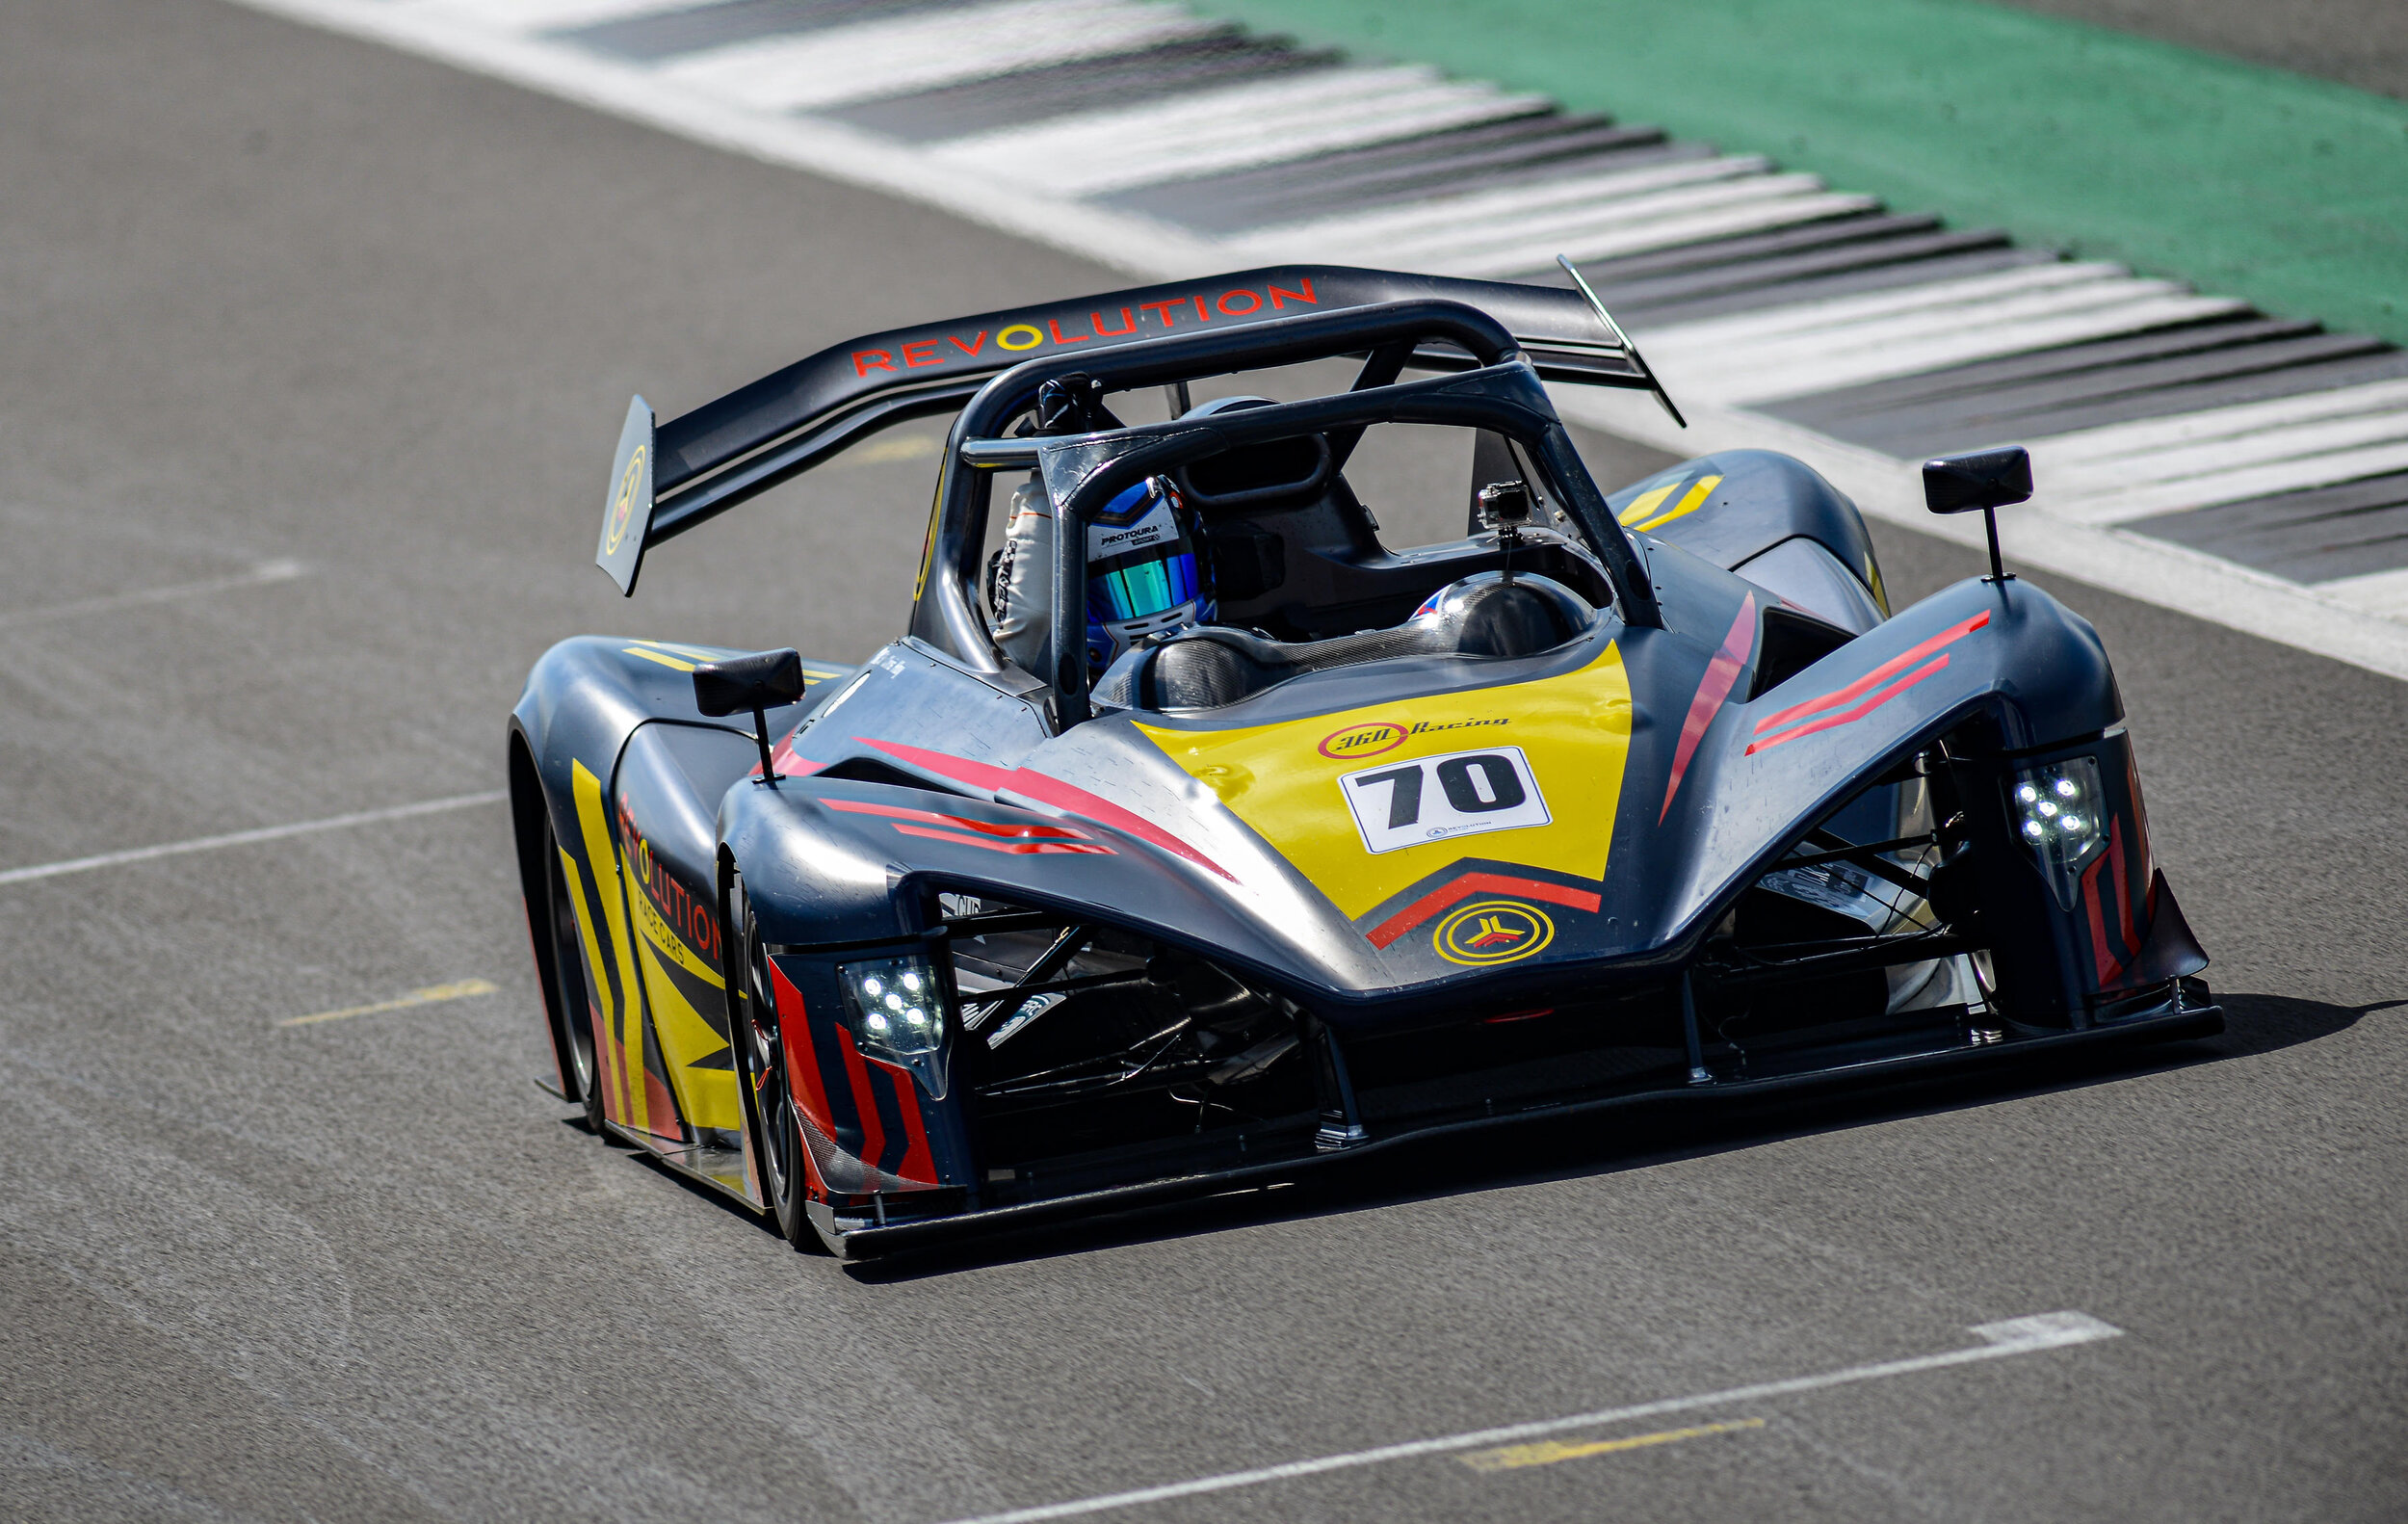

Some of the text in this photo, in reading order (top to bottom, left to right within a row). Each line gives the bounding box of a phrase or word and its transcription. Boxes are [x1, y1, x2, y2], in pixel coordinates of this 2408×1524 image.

[851, 277, 1318, 378] REVOLUTION
[1101, 525, 1159, 546] PROTOURA
[1336, 718, 1510, 750] 360 Racing
[1354, 754, 1527, 829] 70
[661, 926, 685, 966] CARS
